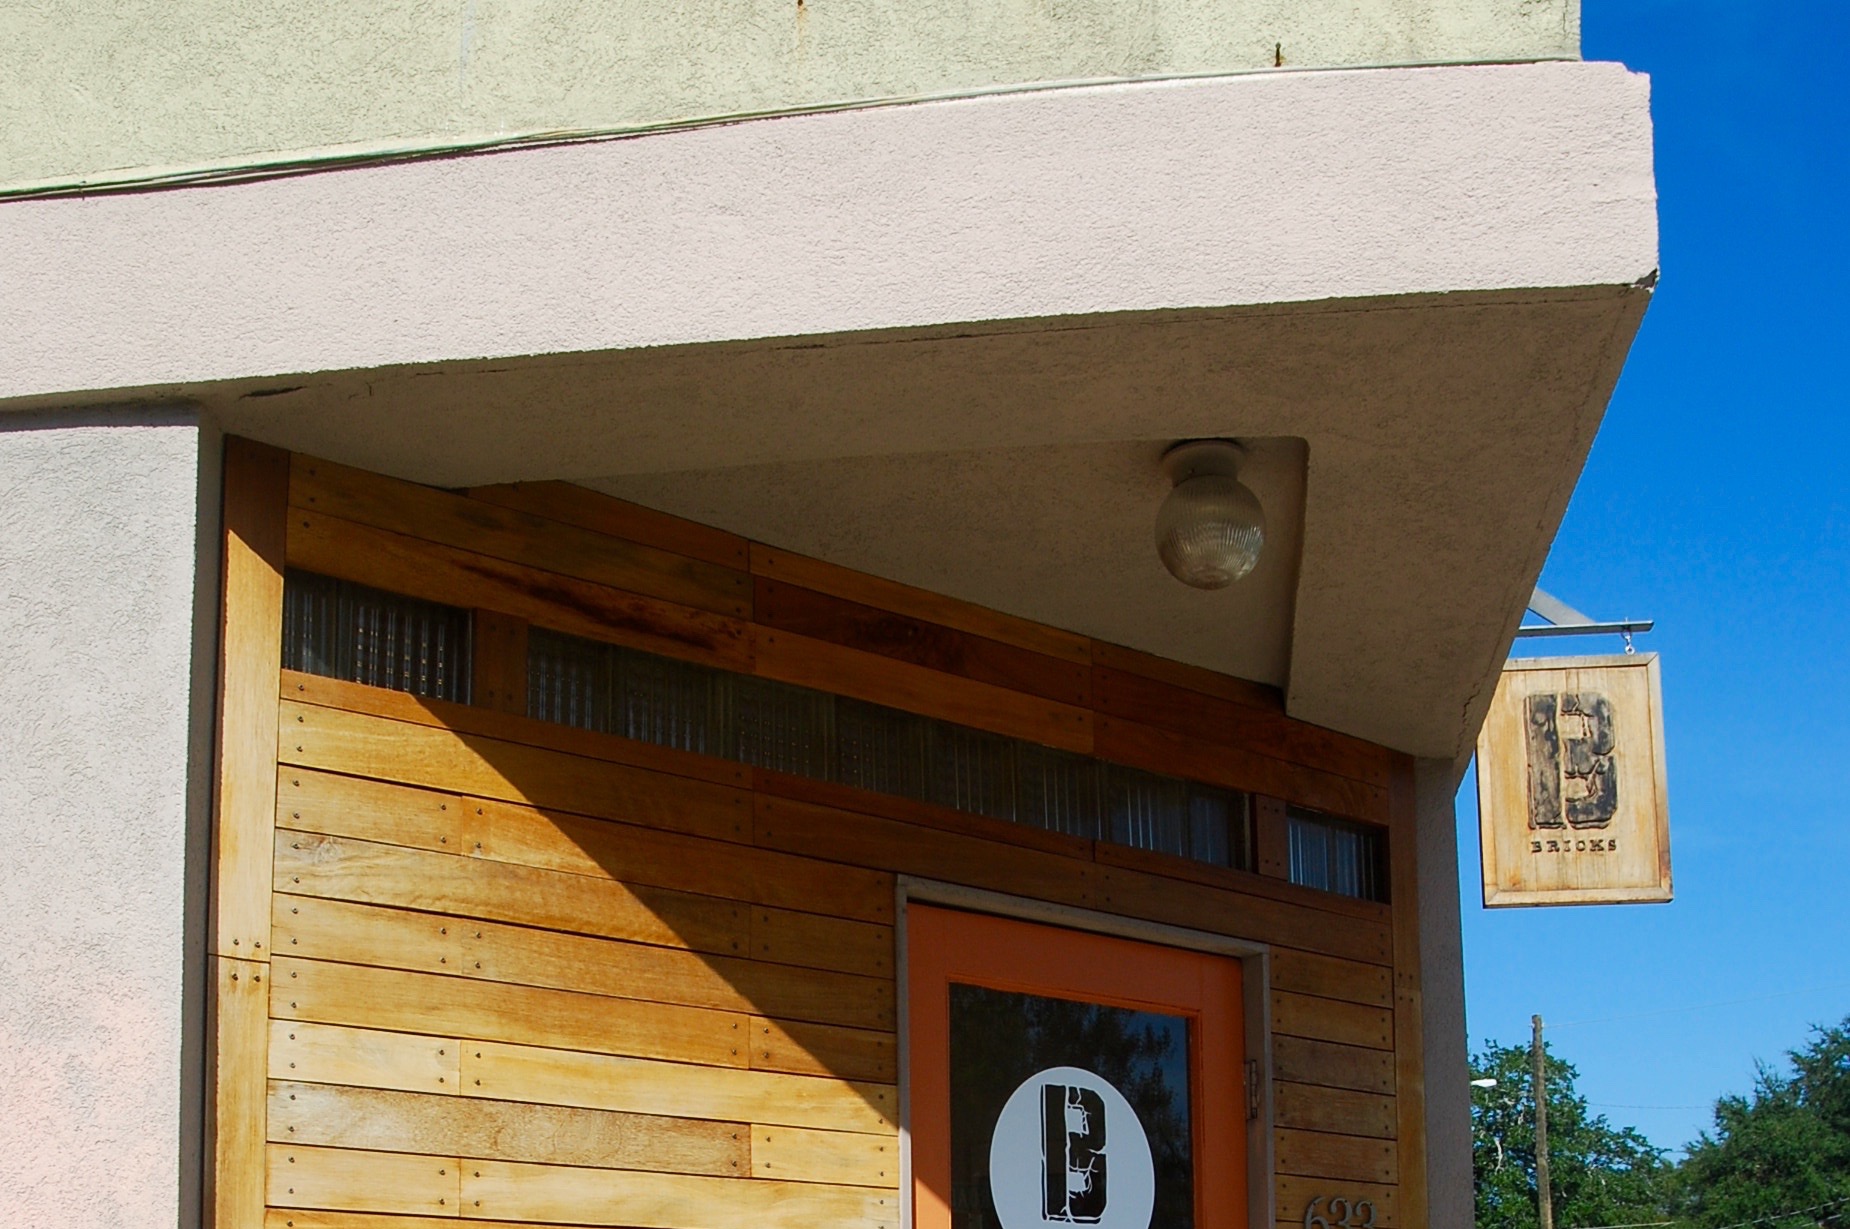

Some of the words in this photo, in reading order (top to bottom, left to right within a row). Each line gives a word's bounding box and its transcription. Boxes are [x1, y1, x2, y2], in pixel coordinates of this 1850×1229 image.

[1523, 692, 1618, 830] B
[1531, 838, 1617, 854] BRICKS
[1040, 1084, 1107, 1224] B
